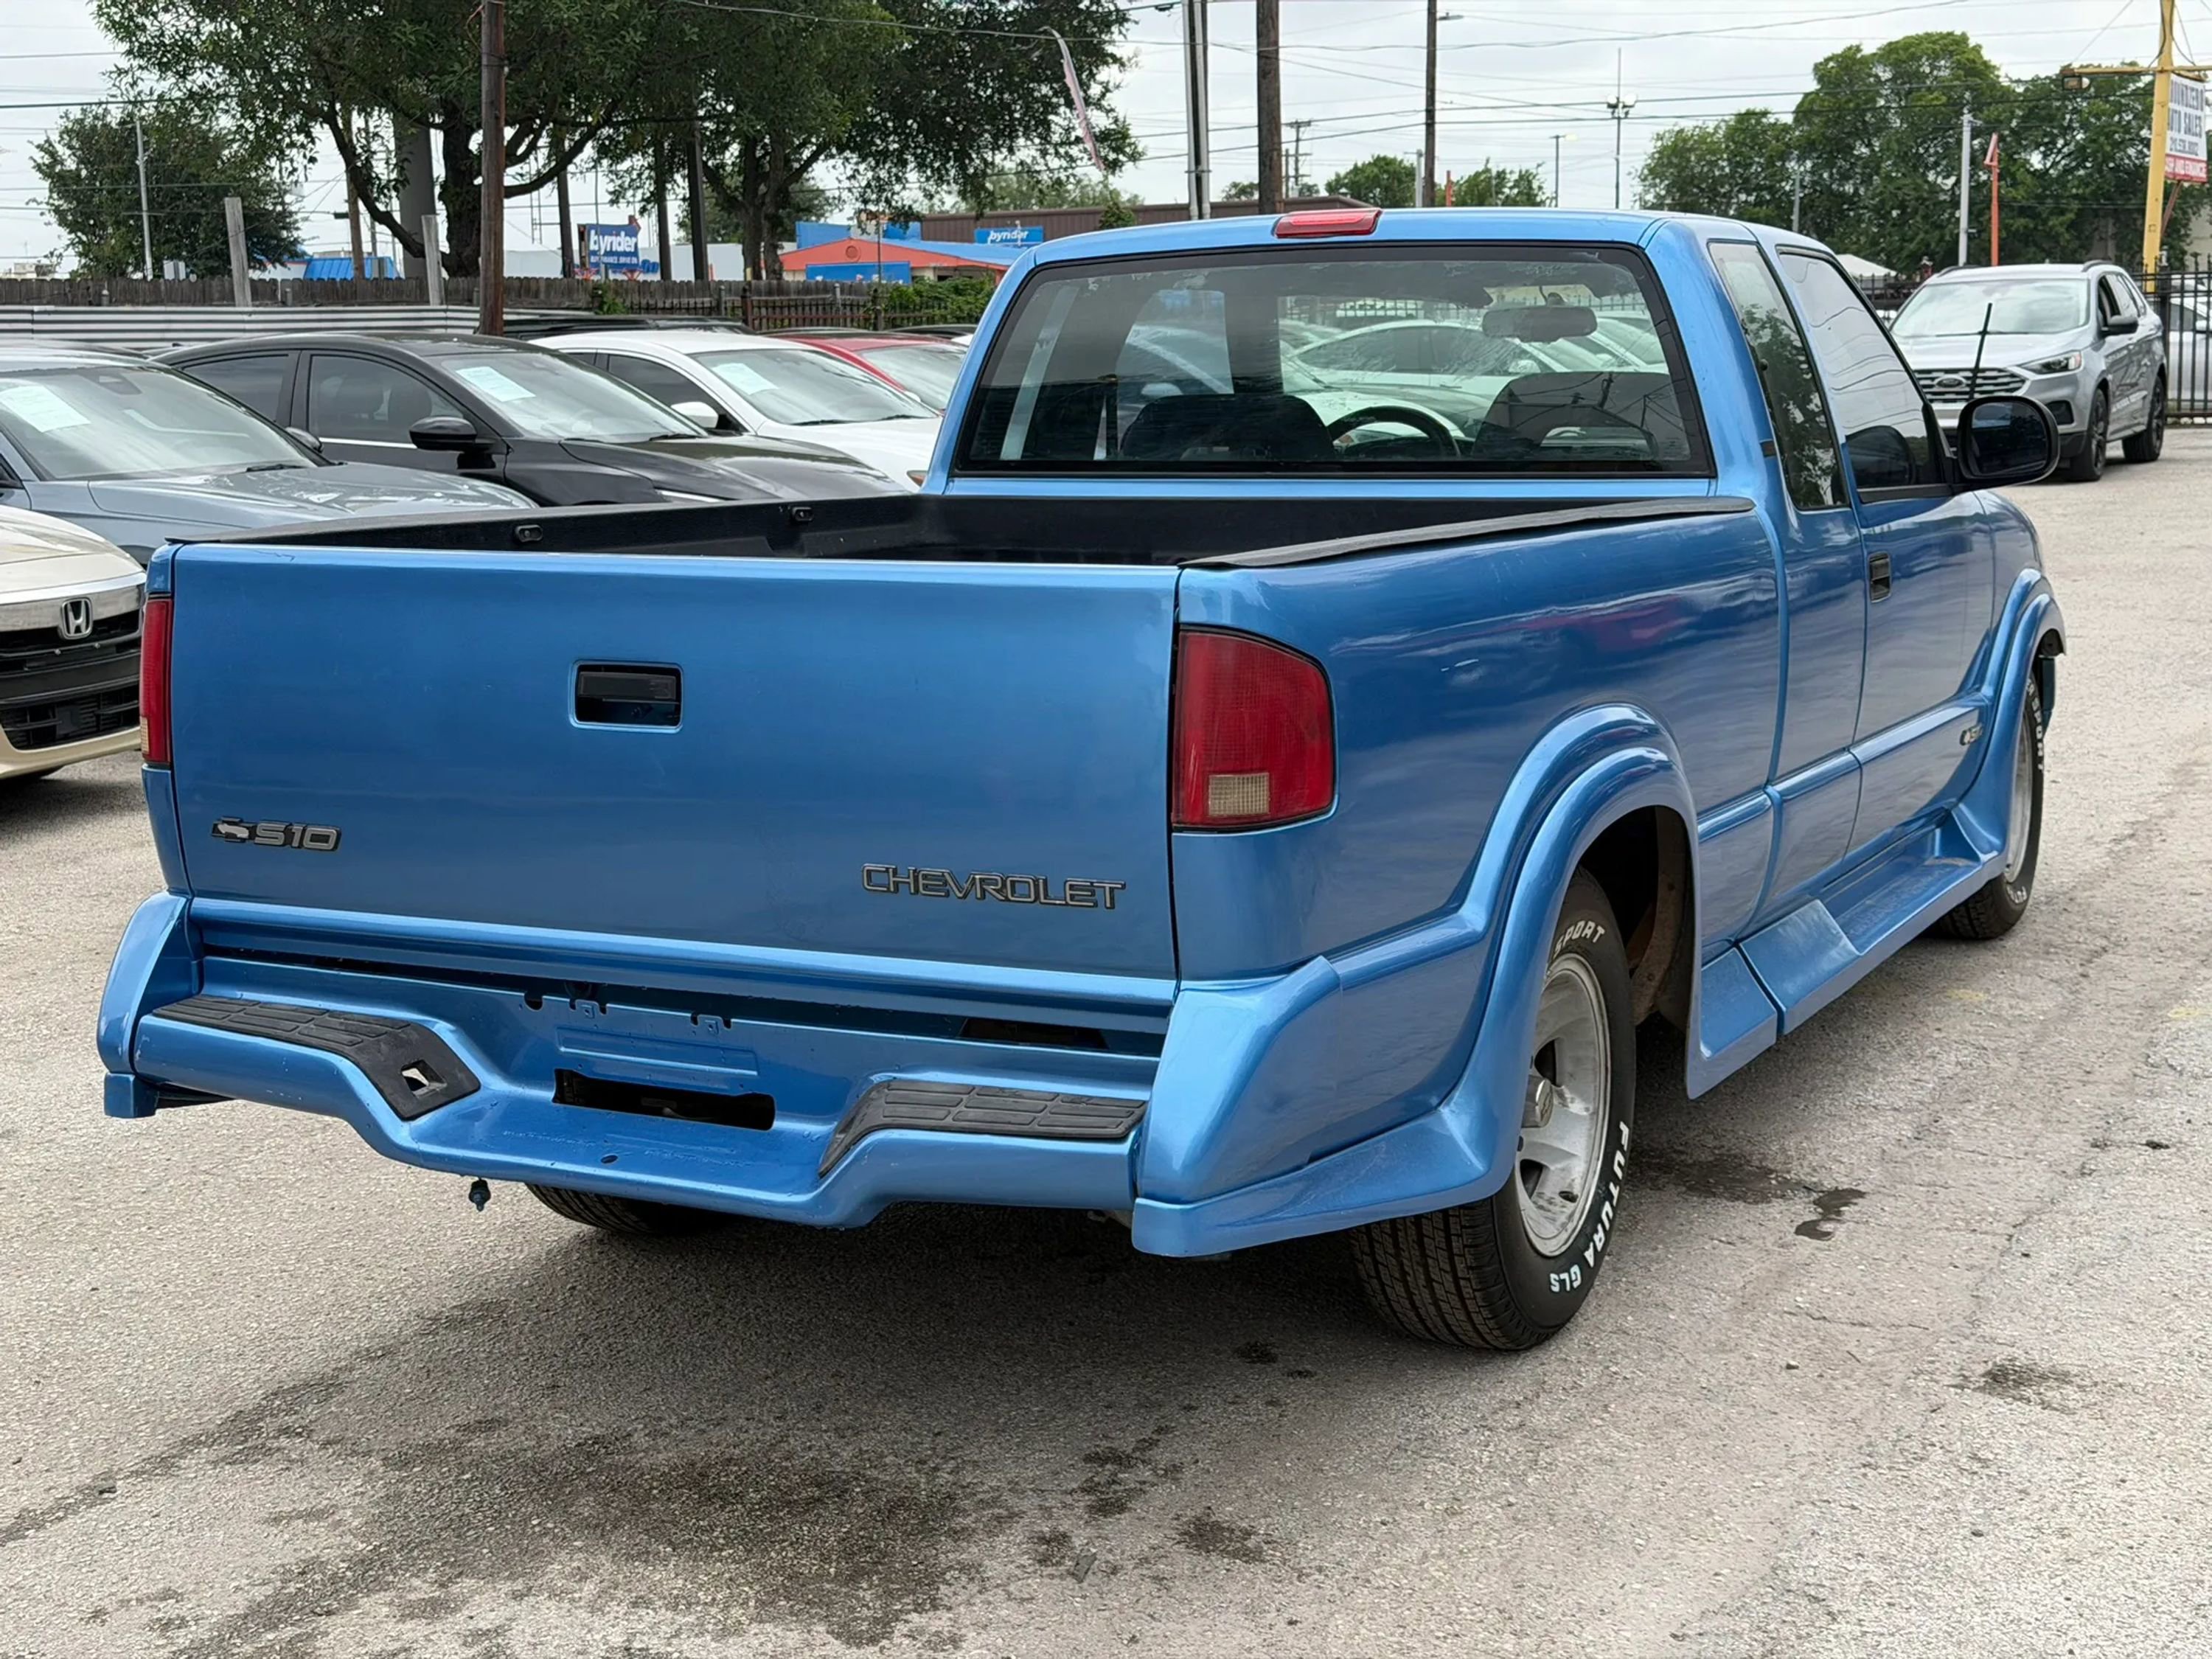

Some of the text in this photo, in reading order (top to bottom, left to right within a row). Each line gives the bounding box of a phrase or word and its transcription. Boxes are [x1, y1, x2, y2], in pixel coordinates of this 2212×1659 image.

[590, 229, 637, 255] byrider
[254, 819, 341, 852] S10
[862, 863, 1126, 909] CHEVROLET
[1553, 919, 1605, 959] SPORT
[1549, 1121, 1630, 1293] FUTURA GLS
